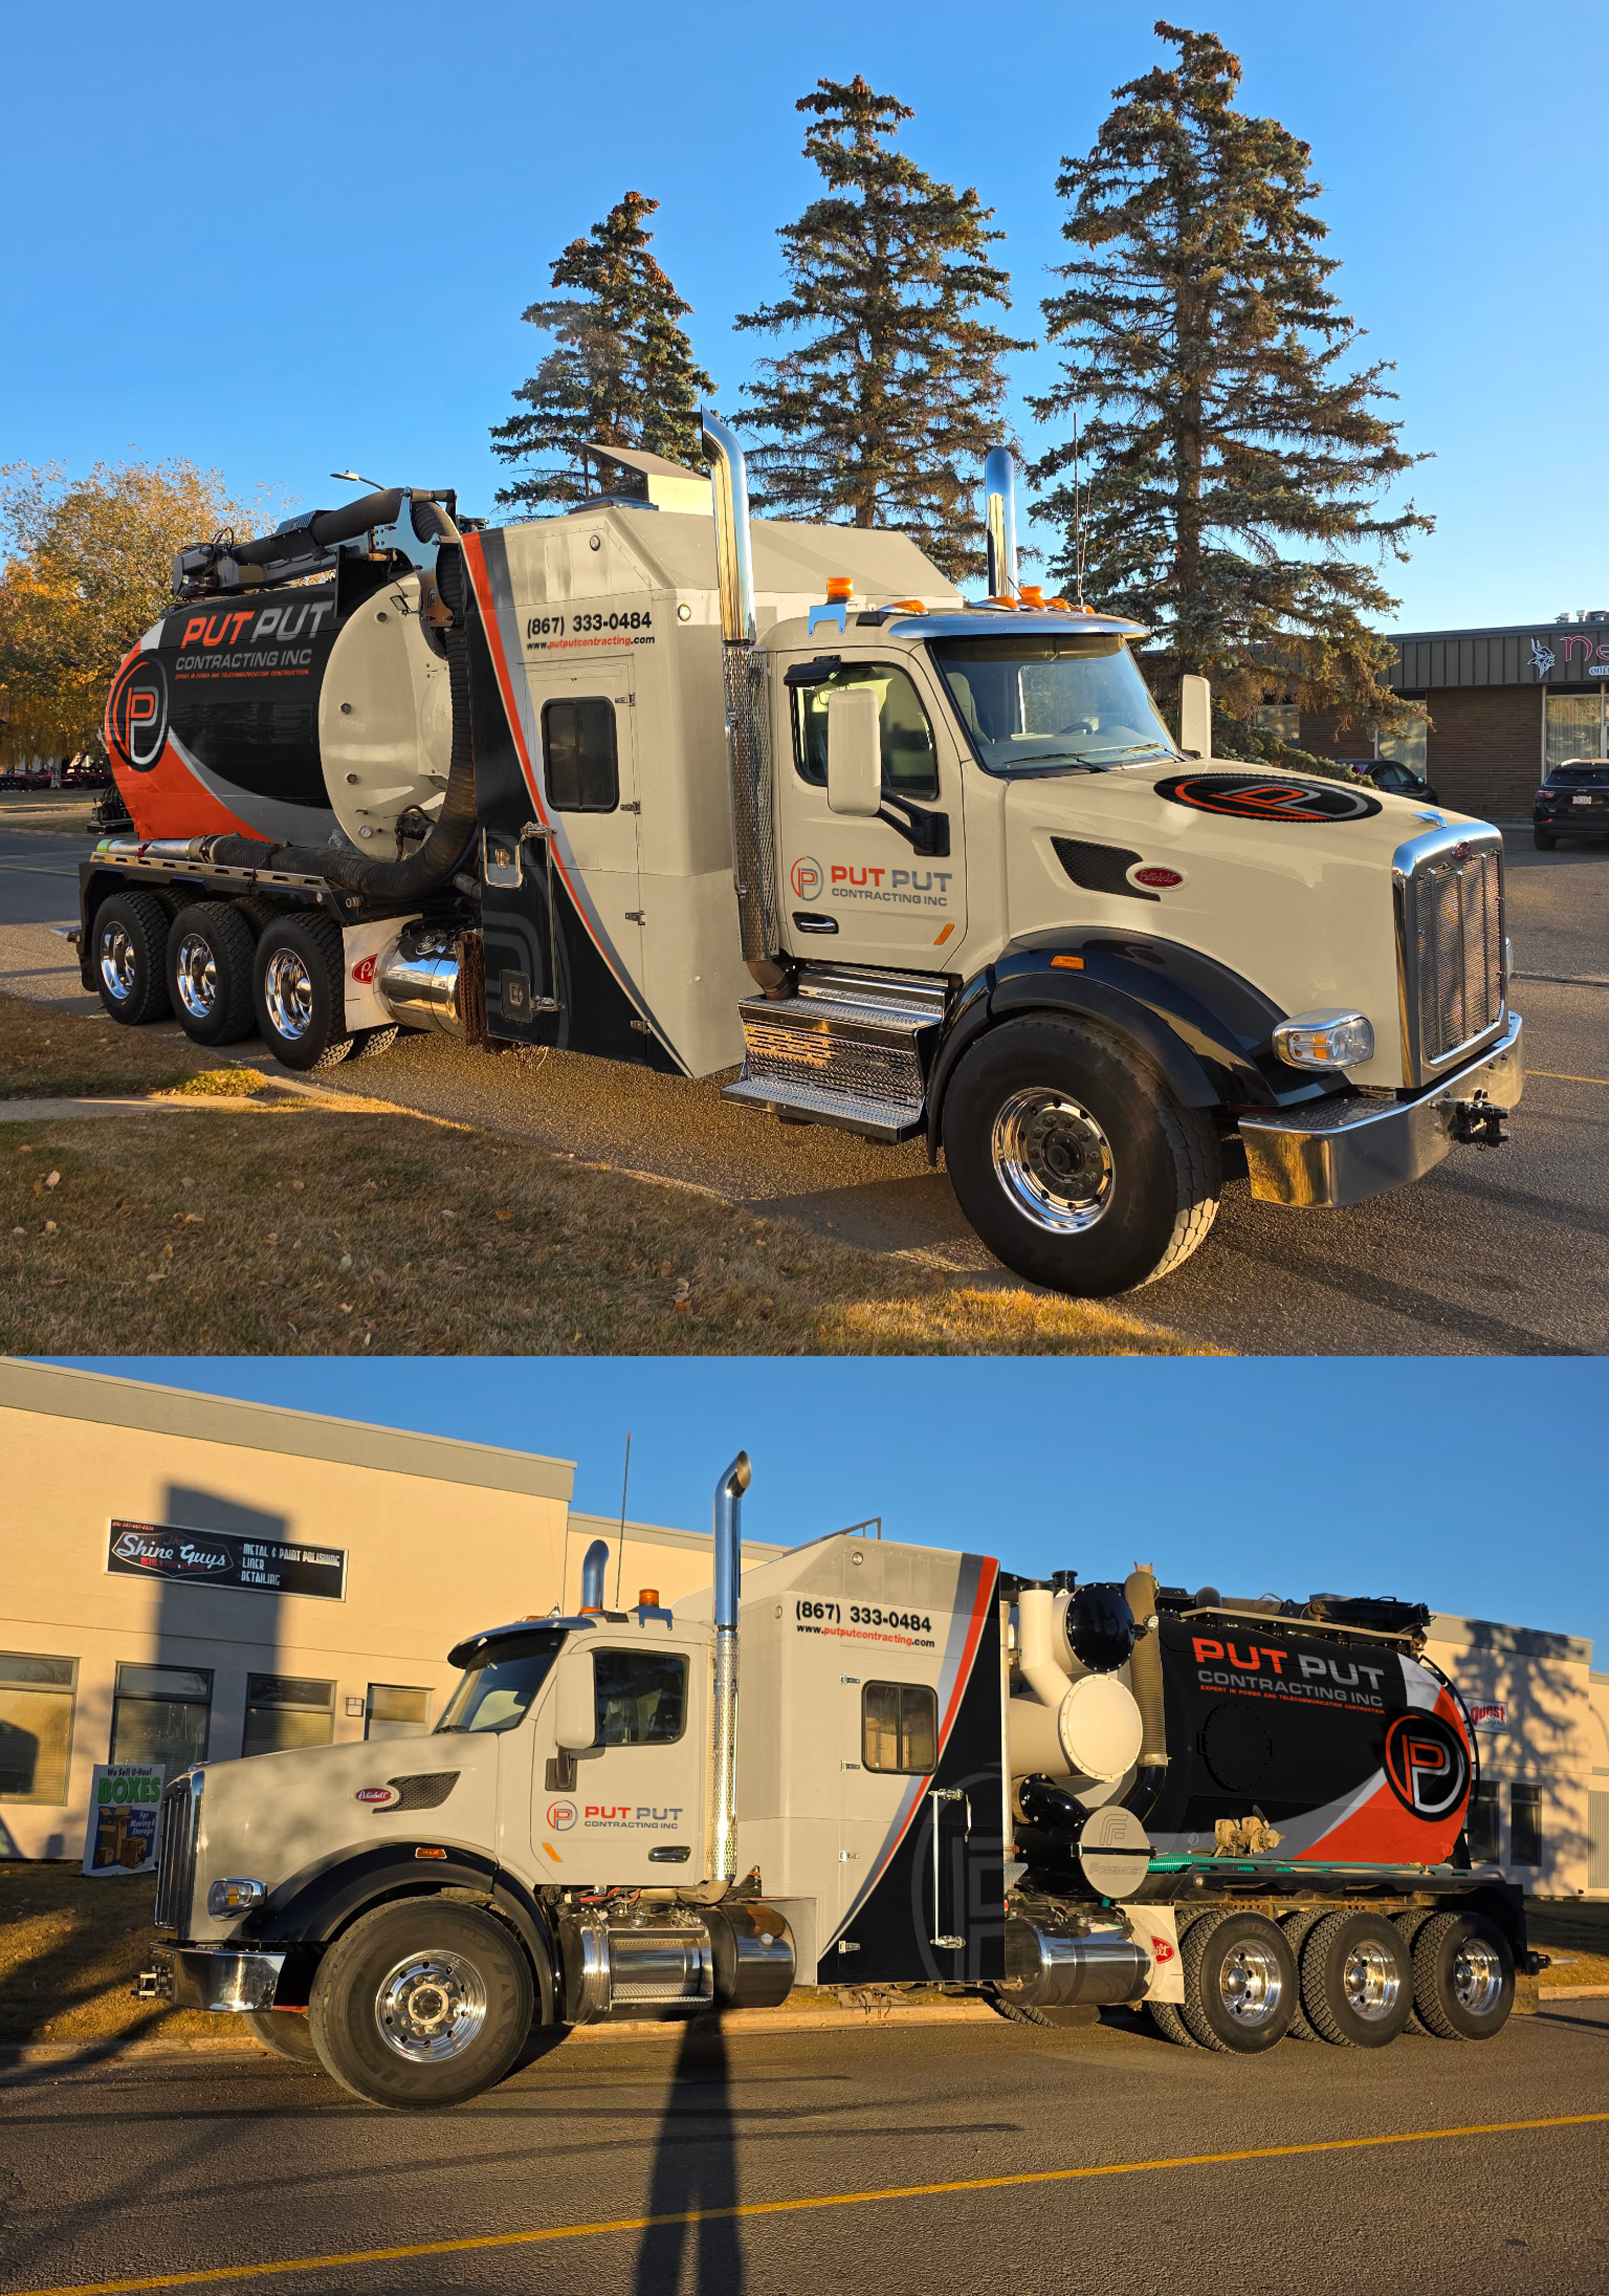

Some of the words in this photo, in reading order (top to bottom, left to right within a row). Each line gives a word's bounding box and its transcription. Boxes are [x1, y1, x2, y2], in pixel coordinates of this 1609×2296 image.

[181, 611, 255, 649] PUT
[250, 601, 333, 643] PUT
[527, 616, 565, 639] (867)
[572, 612, 652, 632] 333-0484
[527, 635, 655, 650] www.putputcontracting.com
[176, 651, 278, 670] CONTRACTING
[280, 649, 313, 665] INC
[831, 866, 885, 887] PUT
[892, 870, 953, 892] PUT
[832, 888, 921, 904] CONTRACTING
[924, 896, 947, 906] INC
[116, 1535, 174, 1560] Shine
[179, 1544, 225, 1569] Guys
[242, 1557, 264, 1570] LINER
[243, 1543, 269, 1557] METAL
[271, 1547, 276, 1558] &
[279, 1548, 301, 1562] PAINT
[303, 1551, 340, 1567] POLISHING
[241, 1571, 280, 1586] DETAILING
[796, 1600, 841, 1623] (867)
[850, 1606, 931, 1632] 333-0484
[797, 1625, 935, 1648] www.putputcontracting.com
[1192, 1637, 1288, 1674] PUT
[1298, 1654, 1385, 1690] PUT
[1198, 1671, 1347, 1701] CONTRACTING
[1351, 1692, 1383, 1707] INC
[1279, 1694, 1343, 1708] TELECOMMUNICATION
[107, 1768, 117, 1776] We
[118, 1768, 130, 1776] Sell
[98, 1778, 160, 1803] BOXES
[130, 1820, 151, 1828] Moving
[585, 1806, 631, 1818] PUT
[636, 1807, 683, 1820] PUT
